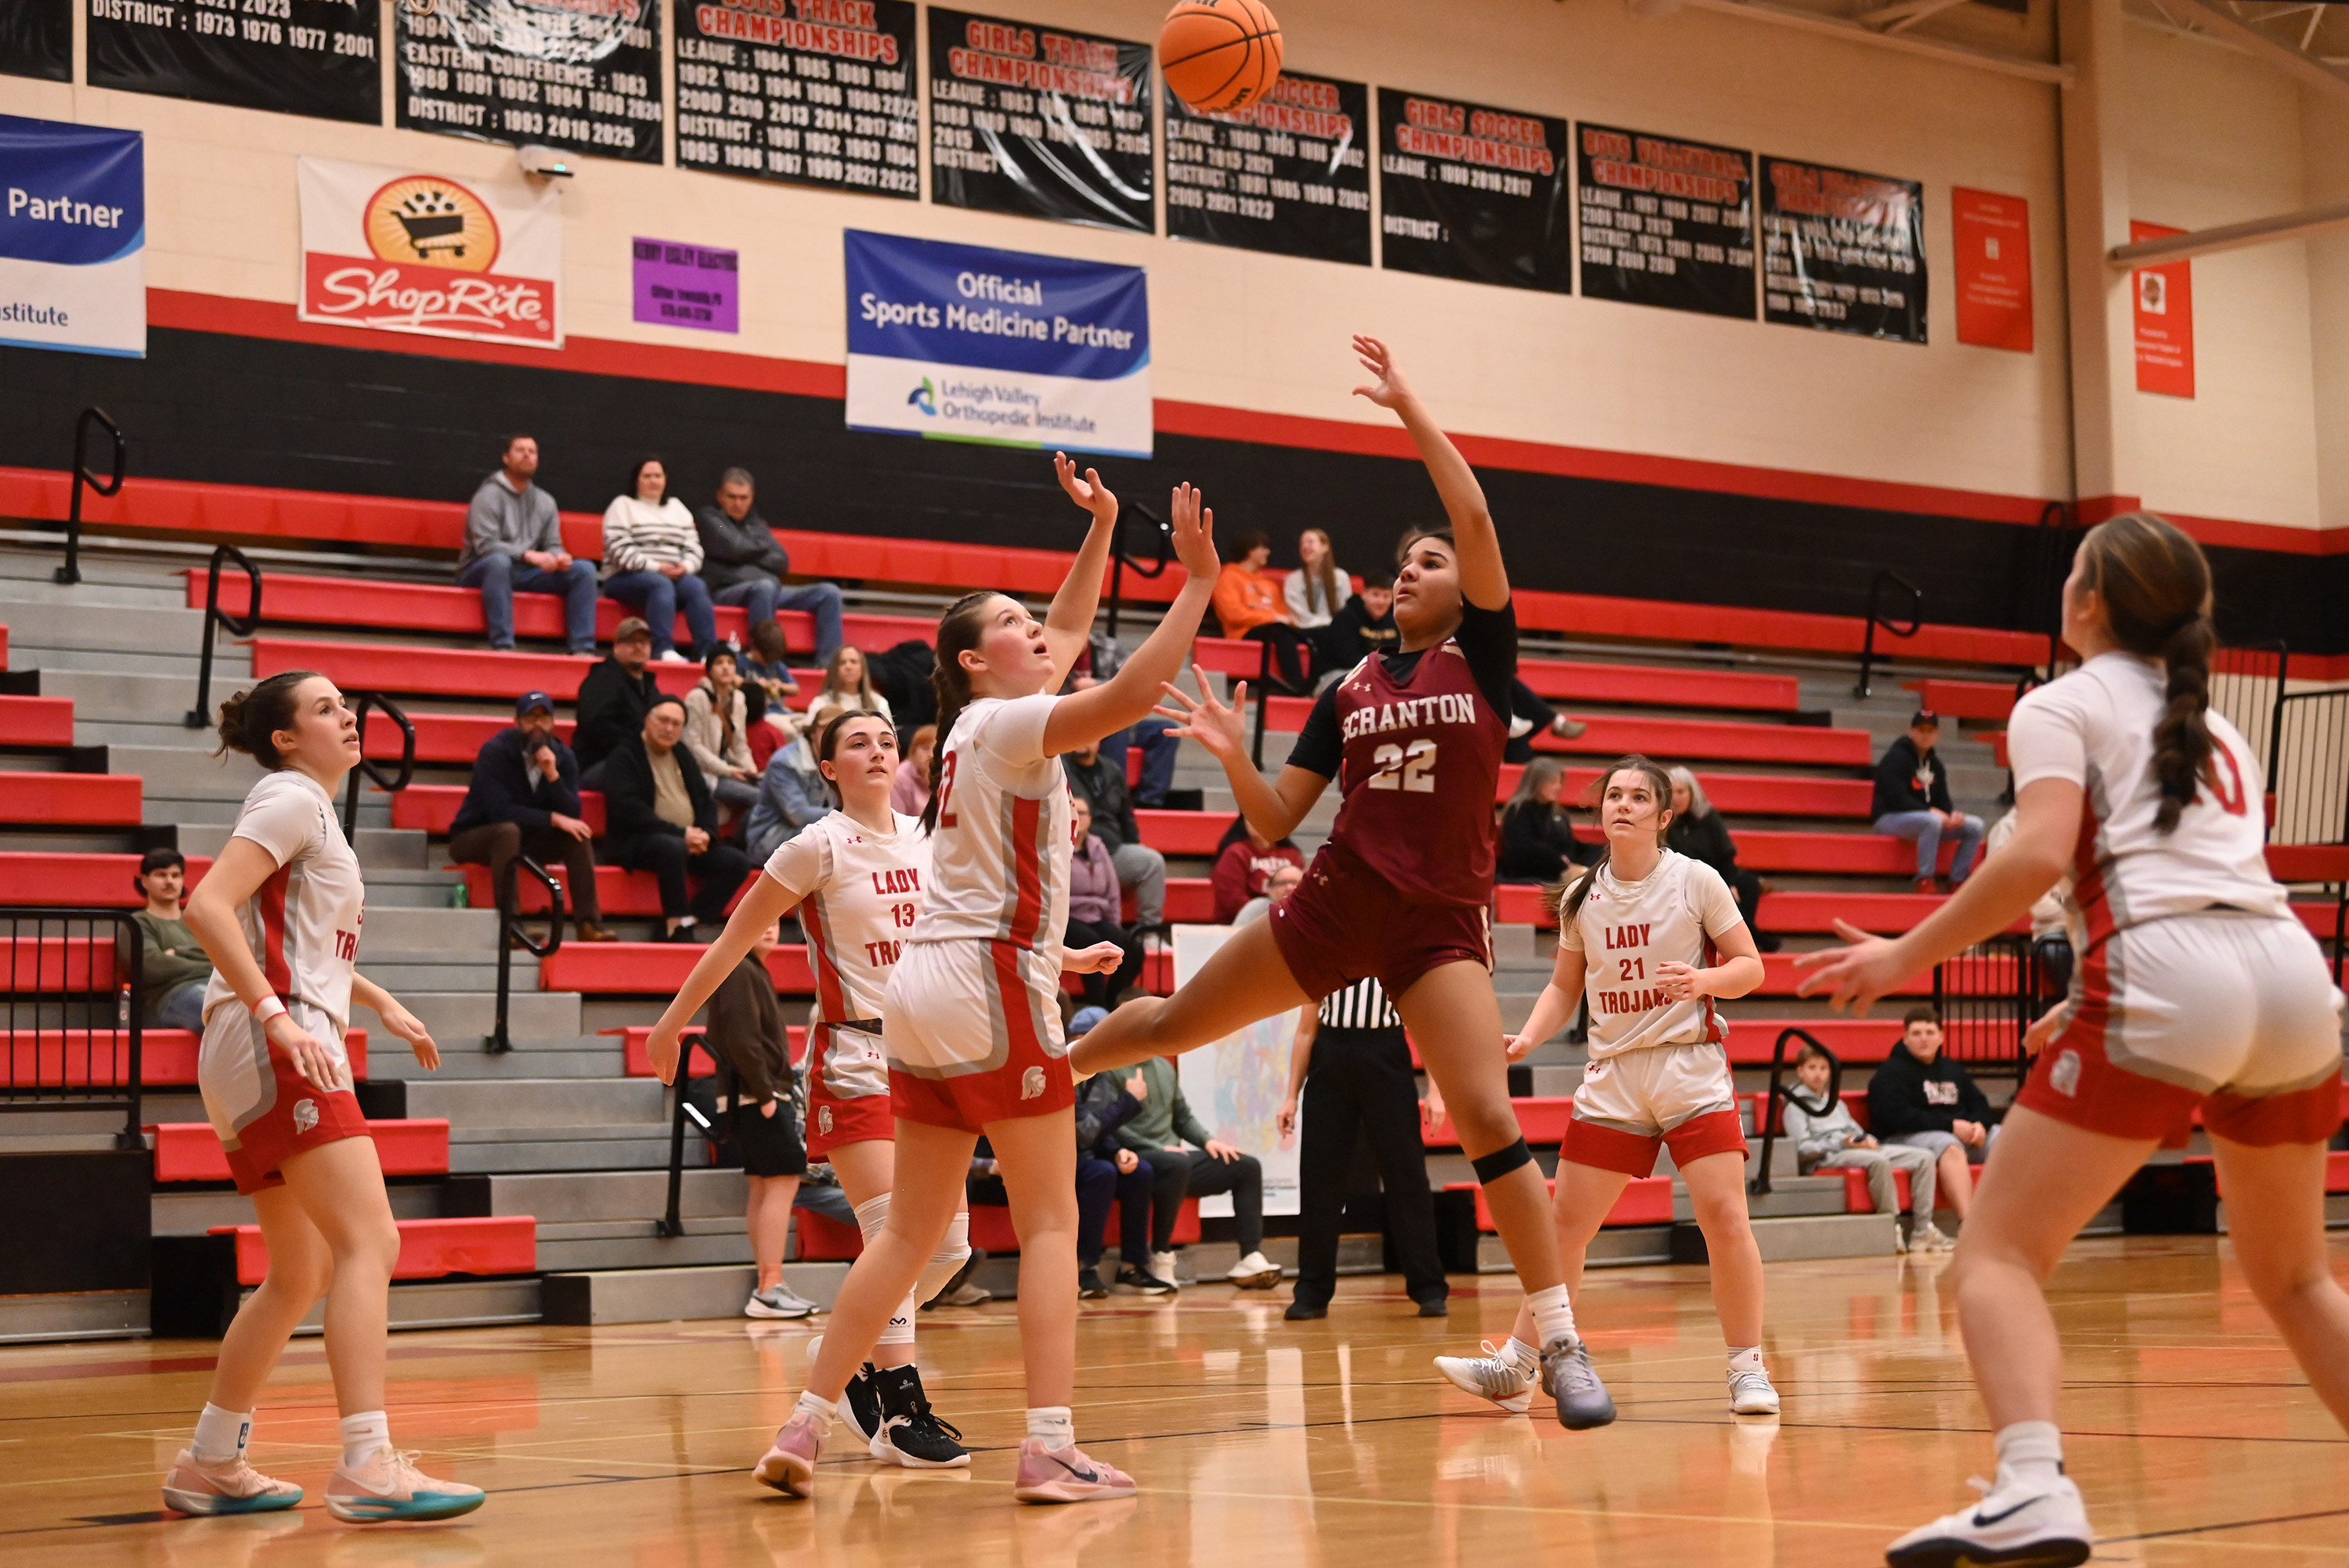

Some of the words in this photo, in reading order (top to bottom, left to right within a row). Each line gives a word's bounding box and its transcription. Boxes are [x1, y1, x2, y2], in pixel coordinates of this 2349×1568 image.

[92, 1, 174, 27] DISTRICT
[196, 12, 235, 37] 1973
[241, 20, 282, 45] 1976
[289, 26, 326, 51] 1977
[333, 32, 375, 59] 2001
[696, 4, 899, 64] CHAMPIONSHIPS
[792, 0, 878, 31] TRACK
[966, 19, 1036, 60] GIRLS
[406, 41, 485, 72] EASTERN
[491, 54, 595, 88] CONFERENCE
[408, 96, 485, 126] DISTRICT
[679, 114, 752, 142] DISTRICT
[1404, 97, 1466, 135] GIRLS
[1470, 110, 1546, 149] SOCCER
[1395, 122, 1554, 176] CHAMPIONSHIPS
[1592, 157, 1738, 206] CHAMPIONSHIPS
[9, 187, 124, 229] Partner
[319, 267, 542, 325] ShopRite
[957, 272, 1043, 306] Official
[0, 302, 69, 326] stitute
[861, 292, 940, 329] Sports
[947, 303, 1048, 341] Medicine
[1053, 316, 1133, 350] Partner
[941, 379, 993, 403] Lehigh
[994, 385, 1041, 407] Valley
[943, 401, 1030, 425] Orthopedic
[1036, 412, 1096, 432] Institute
[1368, 738, 1438, 793] 22
[872, 868, 921, 895] LADY
[891, 903, 915, 928] 13
[1605, 924, 1651, 950] LADY
[1619, 957, 1645, 981] 21
